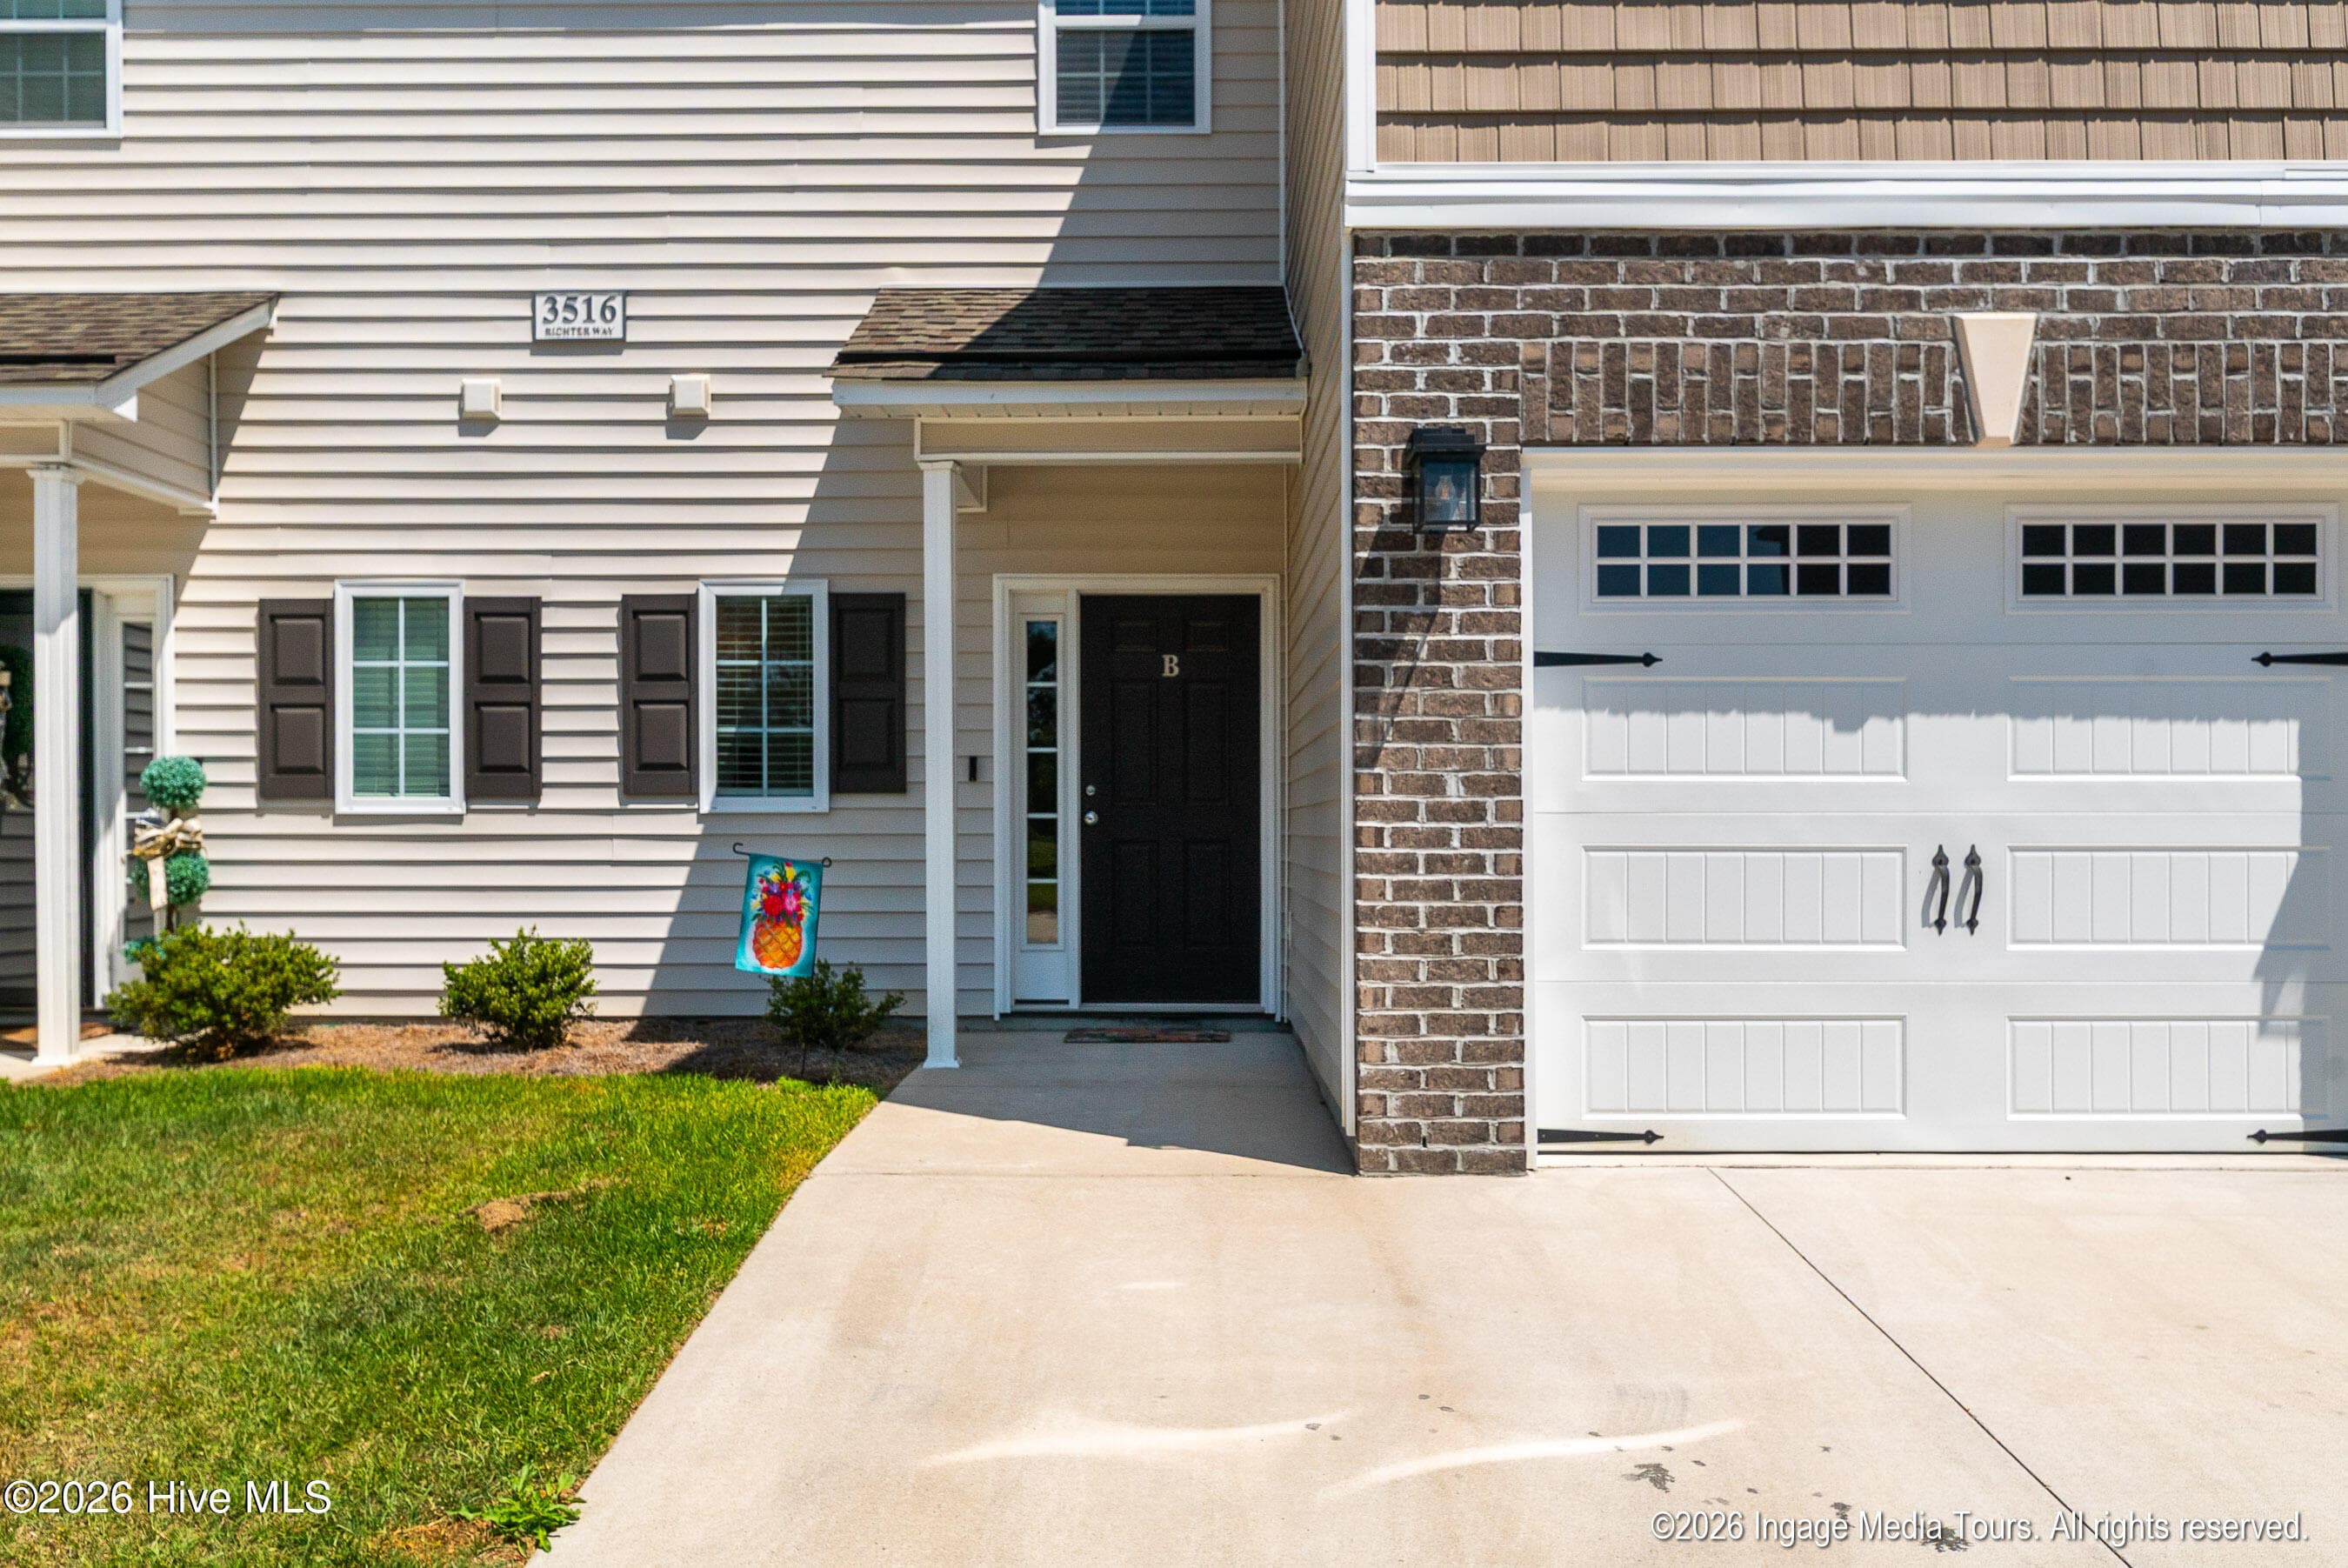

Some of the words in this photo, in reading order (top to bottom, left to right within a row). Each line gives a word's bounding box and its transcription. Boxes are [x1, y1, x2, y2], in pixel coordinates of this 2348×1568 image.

[542, 296, 617, 324] 3516
[545, 327, 590, 337] RICHTER
[592, 327, 614, 337] WAY
[1162, 654, 1179, 677] B
